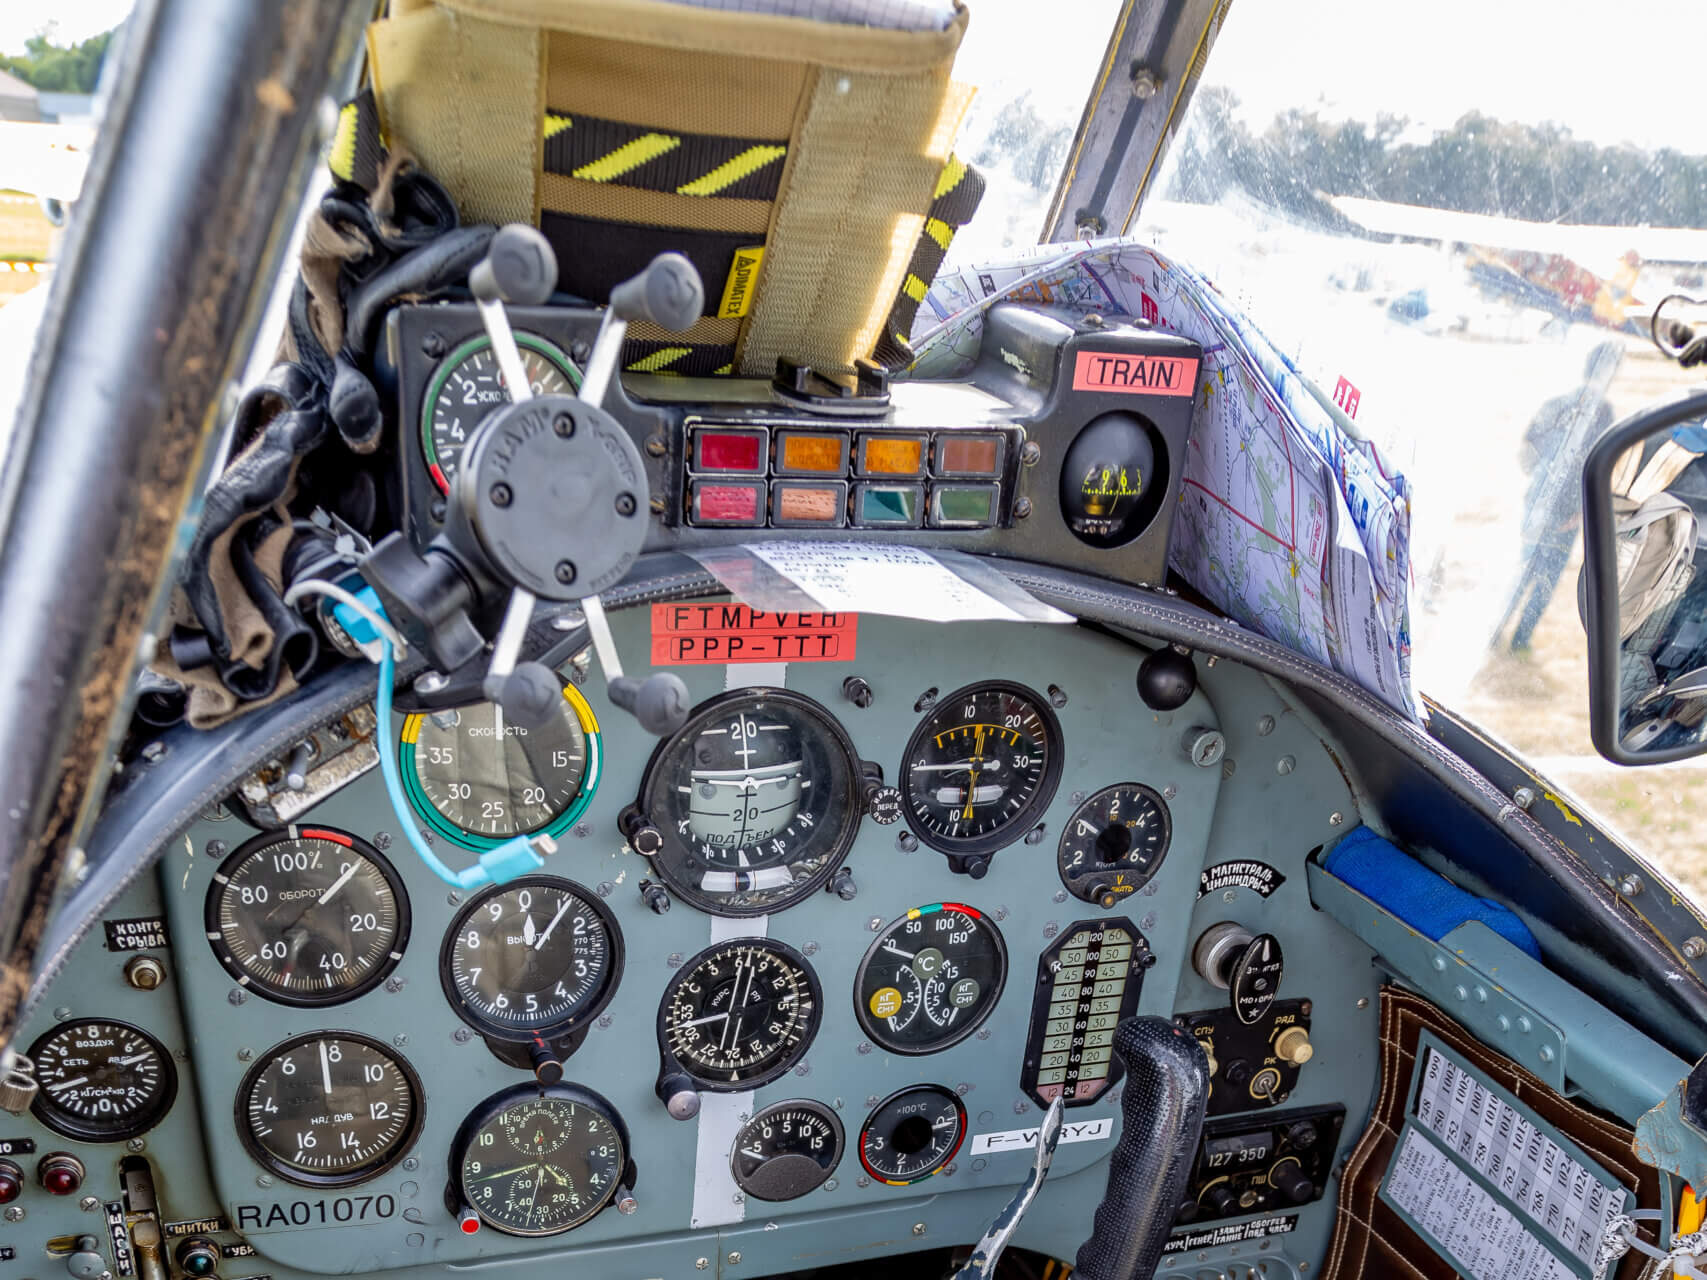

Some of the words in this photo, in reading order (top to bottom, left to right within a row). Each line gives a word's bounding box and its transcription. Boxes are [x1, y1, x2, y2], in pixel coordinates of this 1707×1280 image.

[726, 256, 756, 314] ADIMATEX
[1097, 358, 1174, 387] TRAIN
[679, 636, 832, 659] PPP-TTT
[964, 705, 976, 718] 10
[1005, 715, 1021, 727] 20
[731, 721, 756, 740] 20
[430, 748, 453, 764] 35
[552, 751, 567, 768] 15
[1013, 756, 1028, 768] 30
[448, 784, 471, 799] 30
[523, 788, 545, 804] 20
[482, 802, 504, 817] 25
[733, 807, 759, 821] 20
[950, 810, 960, 821] 10
[274, 850, 323, 872] 100%
[1211, 863, 1272, 881] МАГИСТРАЛЬ
[1207, 875, 1262, 891] ЦИЛИНДРЫ
[242, 885, 268, 904] 80
[279, 888, 327, 900] ОБОРОТ
[519, 890, 531, 909] 0
[490, 904, 502, 921] 9
[350, 914, 376, 932] 20
[573, 917, 586, 935] 2
[906, 921, 922, 933] 50
[935, 918, 954, 931] 100
[116, 934, 166, 948] СРЫВА
[467, 931, 480, 948] 8
[949, 932, 967, 944] 150
[1089, 932, 1102, 942] 120
[1108, 931, 1123, 941] 60
[261, 941, 287, 959] 60
[1067, 953, 1080, 963] 50
[1087, 952, 1099, 960] 100
[1105, 950, 1119, 959] 50
[319, 953, 344, 970] 40
[575, 960, 587, 977] 3
[470, 968, 482, 985] 7
[947, 967, 958, 979] 15
[1064, 970, 1078, 980] 45
[1085, 970, 1095, 978] 90
[1102, 967, 1115, 976] 45
[555, 981, 567, 997] 4
[934, 983, 945, 993] 10
[1061, 988, 1075, 998] 40
[1082, 987, 1092, 995] 80
[1099, 984, 1112, 994] 40
[496, 994, 509, 1008] 6
[526, 995, 537, 1012] 5
[1058, 1005, 1071, 1015] 35
[1079, 1004, 1089, 1012] 70
[1096, 1001, 1109, 1011] 35
[1056, 1022, 1069, 1032] 30
[1076, 1021, 1086, 1029] 60
[1093, 1018, 1106, 1028] 30
[1275, 1014, 1295, 1024] РАД
[1195, 1025, 1214, 1036] СПУ
[76, 1039, 114, 1047] ВОЗДУХ
[1053, 1039, 1066, 1049] 25
[1073, 1037, 1083, 1046] 50
[1089, 1035, 1102, 1045] 25
[329, 1045, 342, 1062] 8
[1051, 1055, 1063, 1065] 20
[1070, 1054, 1080, 1062] 40
[1086, 1052, 1099, 1061] 20
[1264, 1057, 1278, 1065] РК
[282, 1057, 296, 1075] 6
[365, 1064, 384, 1083] 10
[1052, 1071, 1060, 1081] 15
[1084, 1068, 1092, 1077] 15
[1049, 1088, 1058, 1098] 12
[1064, 1087, 1074, 1095] 24
[1080, 1084, 1089, 1094] 12
[1421, 1098, 1432, 1122] 748
[1429, 1055, 1441, 1080] 999
[265, 1097, 278, 1114] 4
[1434, 1110, 1445, 1133] 750
[1442, 1063, 1457, 1094] 1002
[370, 1102, 389, 1120] 12
[1447, 1121, 1458, 1144] 752
[1455, 1073, 1469, 1105] 1005
[1461, 1132, 1473, 1155] 754
[1470, 1083, 1485, 1116] 1007
[783, 1121, 792, 1134] 5
[800, 1125, 812, 1138] 10
[1474, 1143, 1487, 1167] 758
[1485, 1095, 1498, 1127] 1010
[297, 1131, 317, 1148] 16
[341, 1131, 360, 1149] 14
[480, 1133, 493, 1146] 10
[811, 1137, 823, 1150] 15
[1489, 1155, 1500, 1179] 760
[1499, 1108, 1514, 1139] 1013
[1209, 1152, 1232, 1168] 127
[1239, 1147, 1266, 1162] 350
[1503, 1167, 1516, 1191] 762
[1512, 1119, 1528, 1151] 1015
[1517, 1179, 1529, 1202] 764
[1528, 1132, 1543, 1164] 1018
[518, 1180, 532, 1188] 50
[1532, 1191, 1544, 1215] 768
[1542, 1143, 1558, 1176] 1021
[552, 1194, 565, 1202] 20
[1547, 1204, 1560, 1227] 770
[1557, 1155, 1573, 1188] 1024
[520, 1198, 532, 1206] 40
[536, 1206, 550, 1214] 30
[1562, 1217, 1575, 1242] 772
[1572, 1168, 1588, 1200] 1026
[237, 1194, 395, 1229] RA01070
[1578, 1230, 1591, 1256] 774
[1589, 1182, 1605, 1214] 1029
[110, 1213, 129, 1270] ШАССИ
